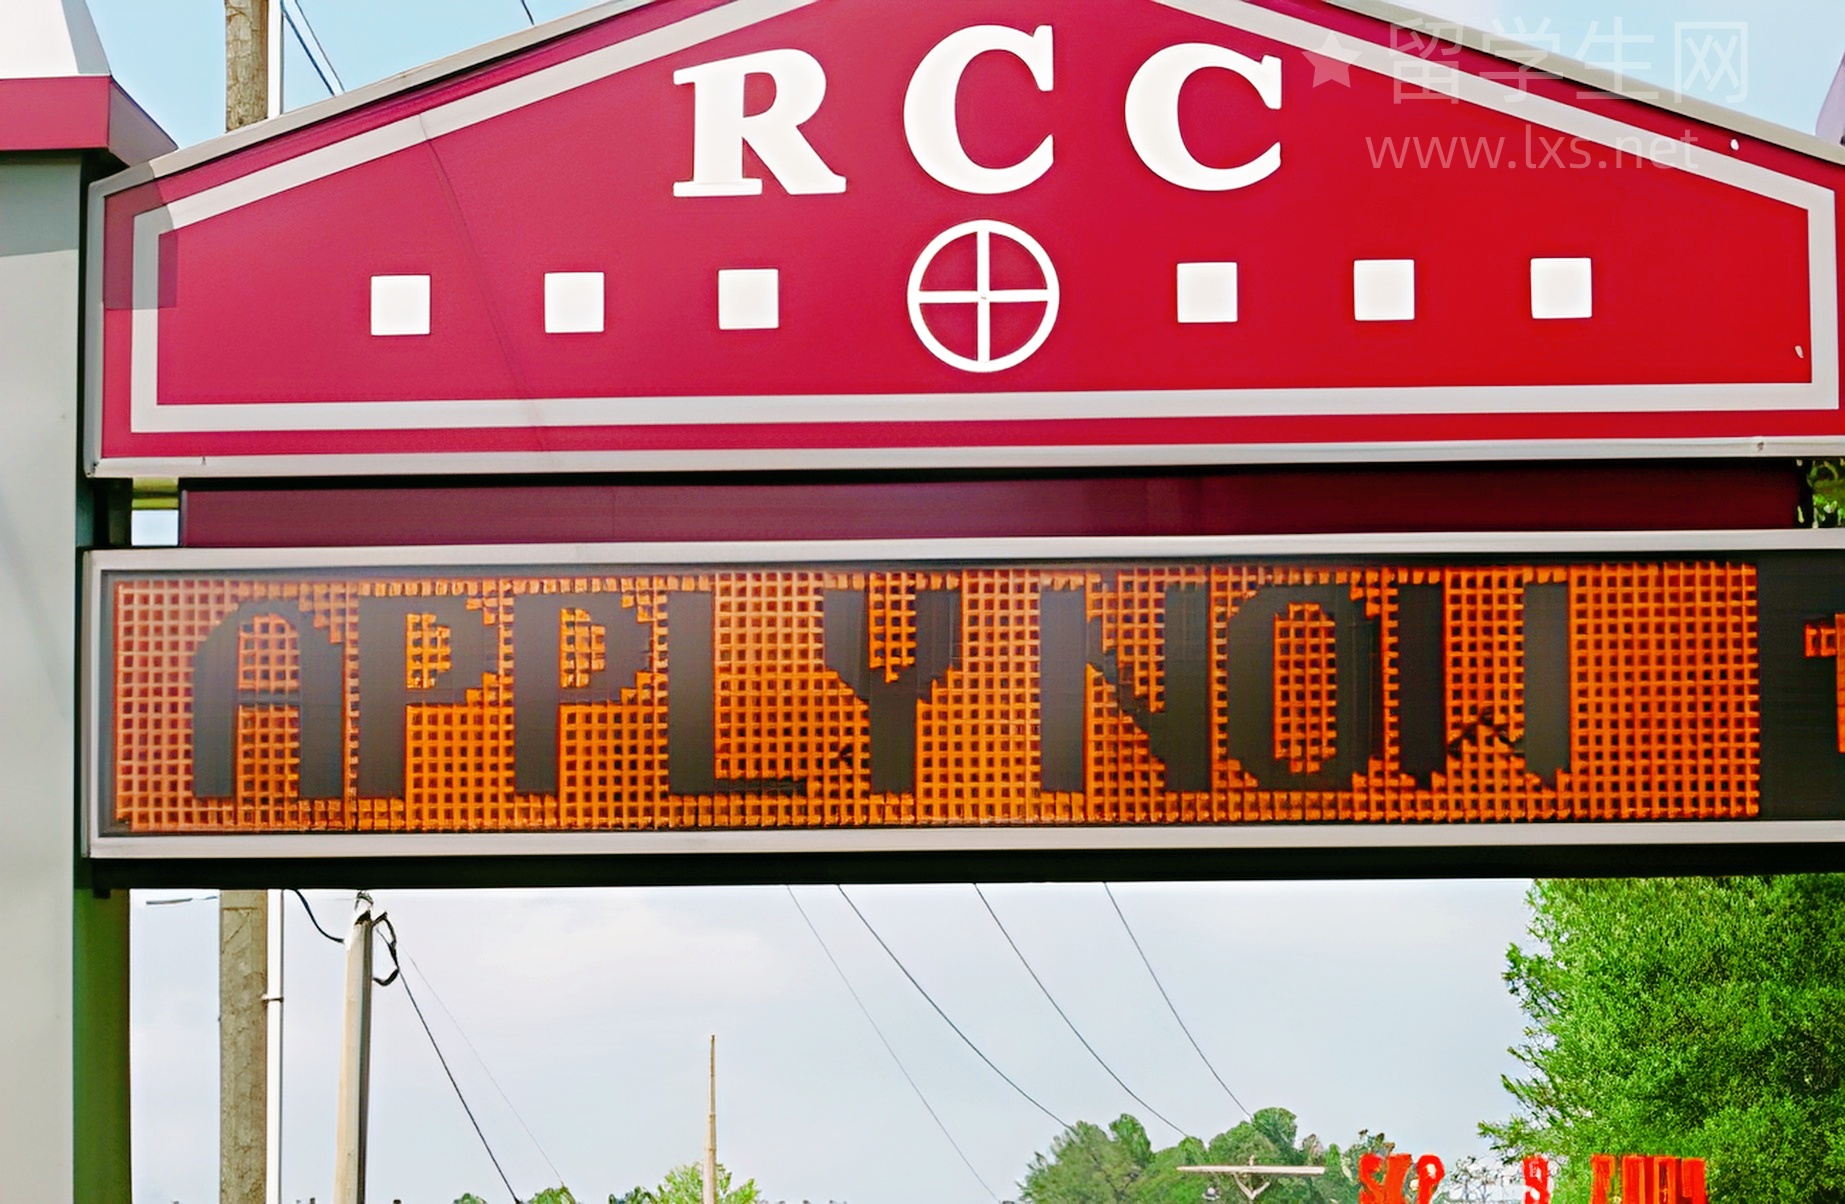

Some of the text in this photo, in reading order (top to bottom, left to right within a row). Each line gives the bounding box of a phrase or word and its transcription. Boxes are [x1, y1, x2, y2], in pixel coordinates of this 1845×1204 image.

[672, 24, 1283, 197] RCC
[191, 588, 962, 800] APPLY
[1040, 580, 1570, 793] NOW
